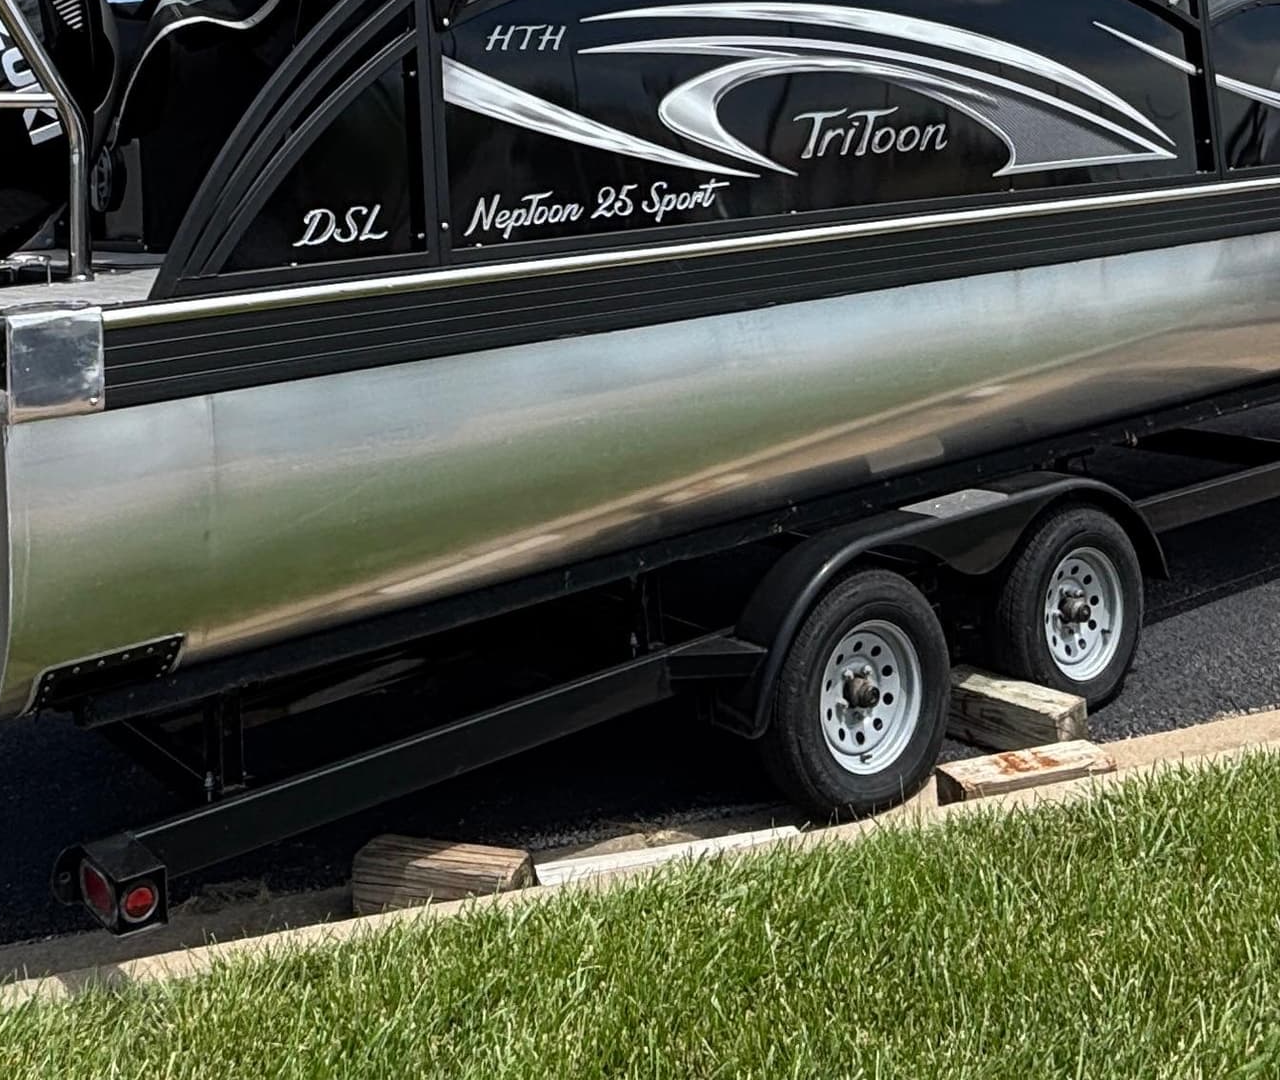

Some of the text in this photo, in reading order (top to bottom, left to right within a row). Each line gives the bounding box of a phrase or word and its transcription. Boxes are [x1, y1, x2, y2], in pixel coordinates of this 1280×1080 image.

[484, 24, 567, 51] HTH
[793, 106, 948, 159] TriToon
[292, 204, 389, 247] DSL
[464, 178, 730, 240] NepToon 25 Sport
